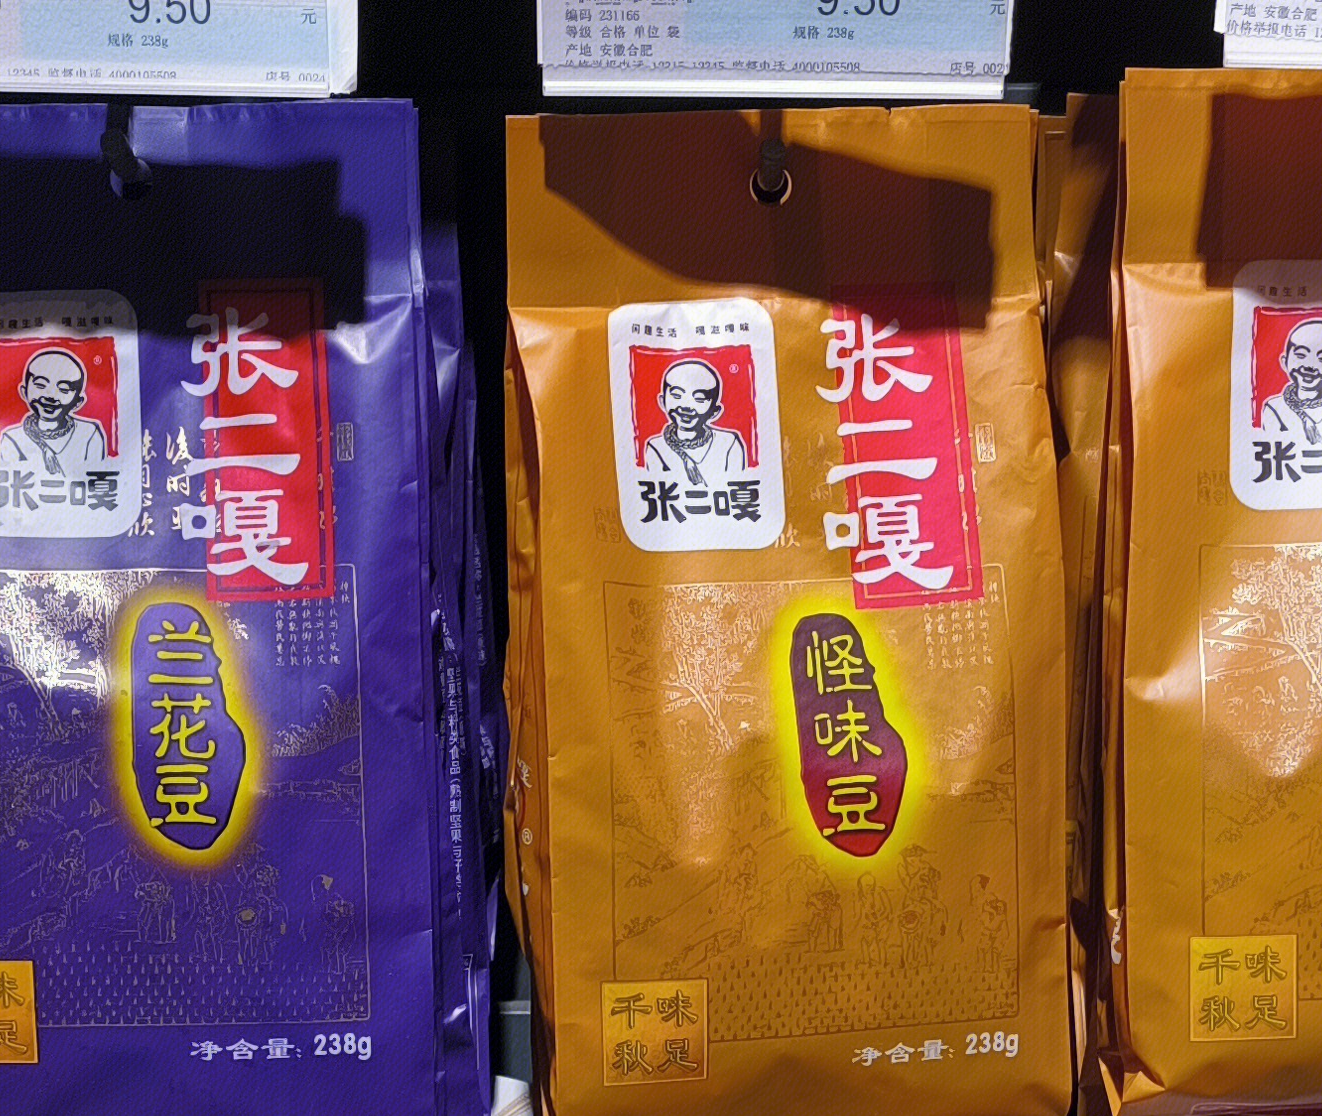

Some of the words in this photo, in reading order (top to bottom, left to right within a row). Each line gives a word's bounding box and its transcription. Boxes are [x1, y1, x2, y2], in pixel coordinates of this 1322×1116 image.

[301, 8, 317, 24] 元
[1230, 4, 1255, 17] 产地
[1264, 5, 1317, 21] 安徽合肥
[599, 25, 626, 38] 合格
[634, 25, 660, 38] 单位
[827, 26, 854, 41] 238g
[1226, 20, 1307, 37] 价格举报电话
[141, 34, 169, 48] 238g
[565, 43, 592, 57] 产地
[599, 43, 653, 57] 安徽合肥
[180, 307, 310, 586] 张二嘎
[815, 313, 954, 590] 张二嘎
[638, 479, 761, 524] 张二嘎
[148, 620, 217, 828] 兰花豆
[805, 630, 887, 837] 怪味豆
[190, 1037, 303, 1061] 净含量:
[313, 1032, 372, 1061] 238g
[852, 1039, 955, 1066] 净含量:
[965, 1031, 1019, 1057] 238g
